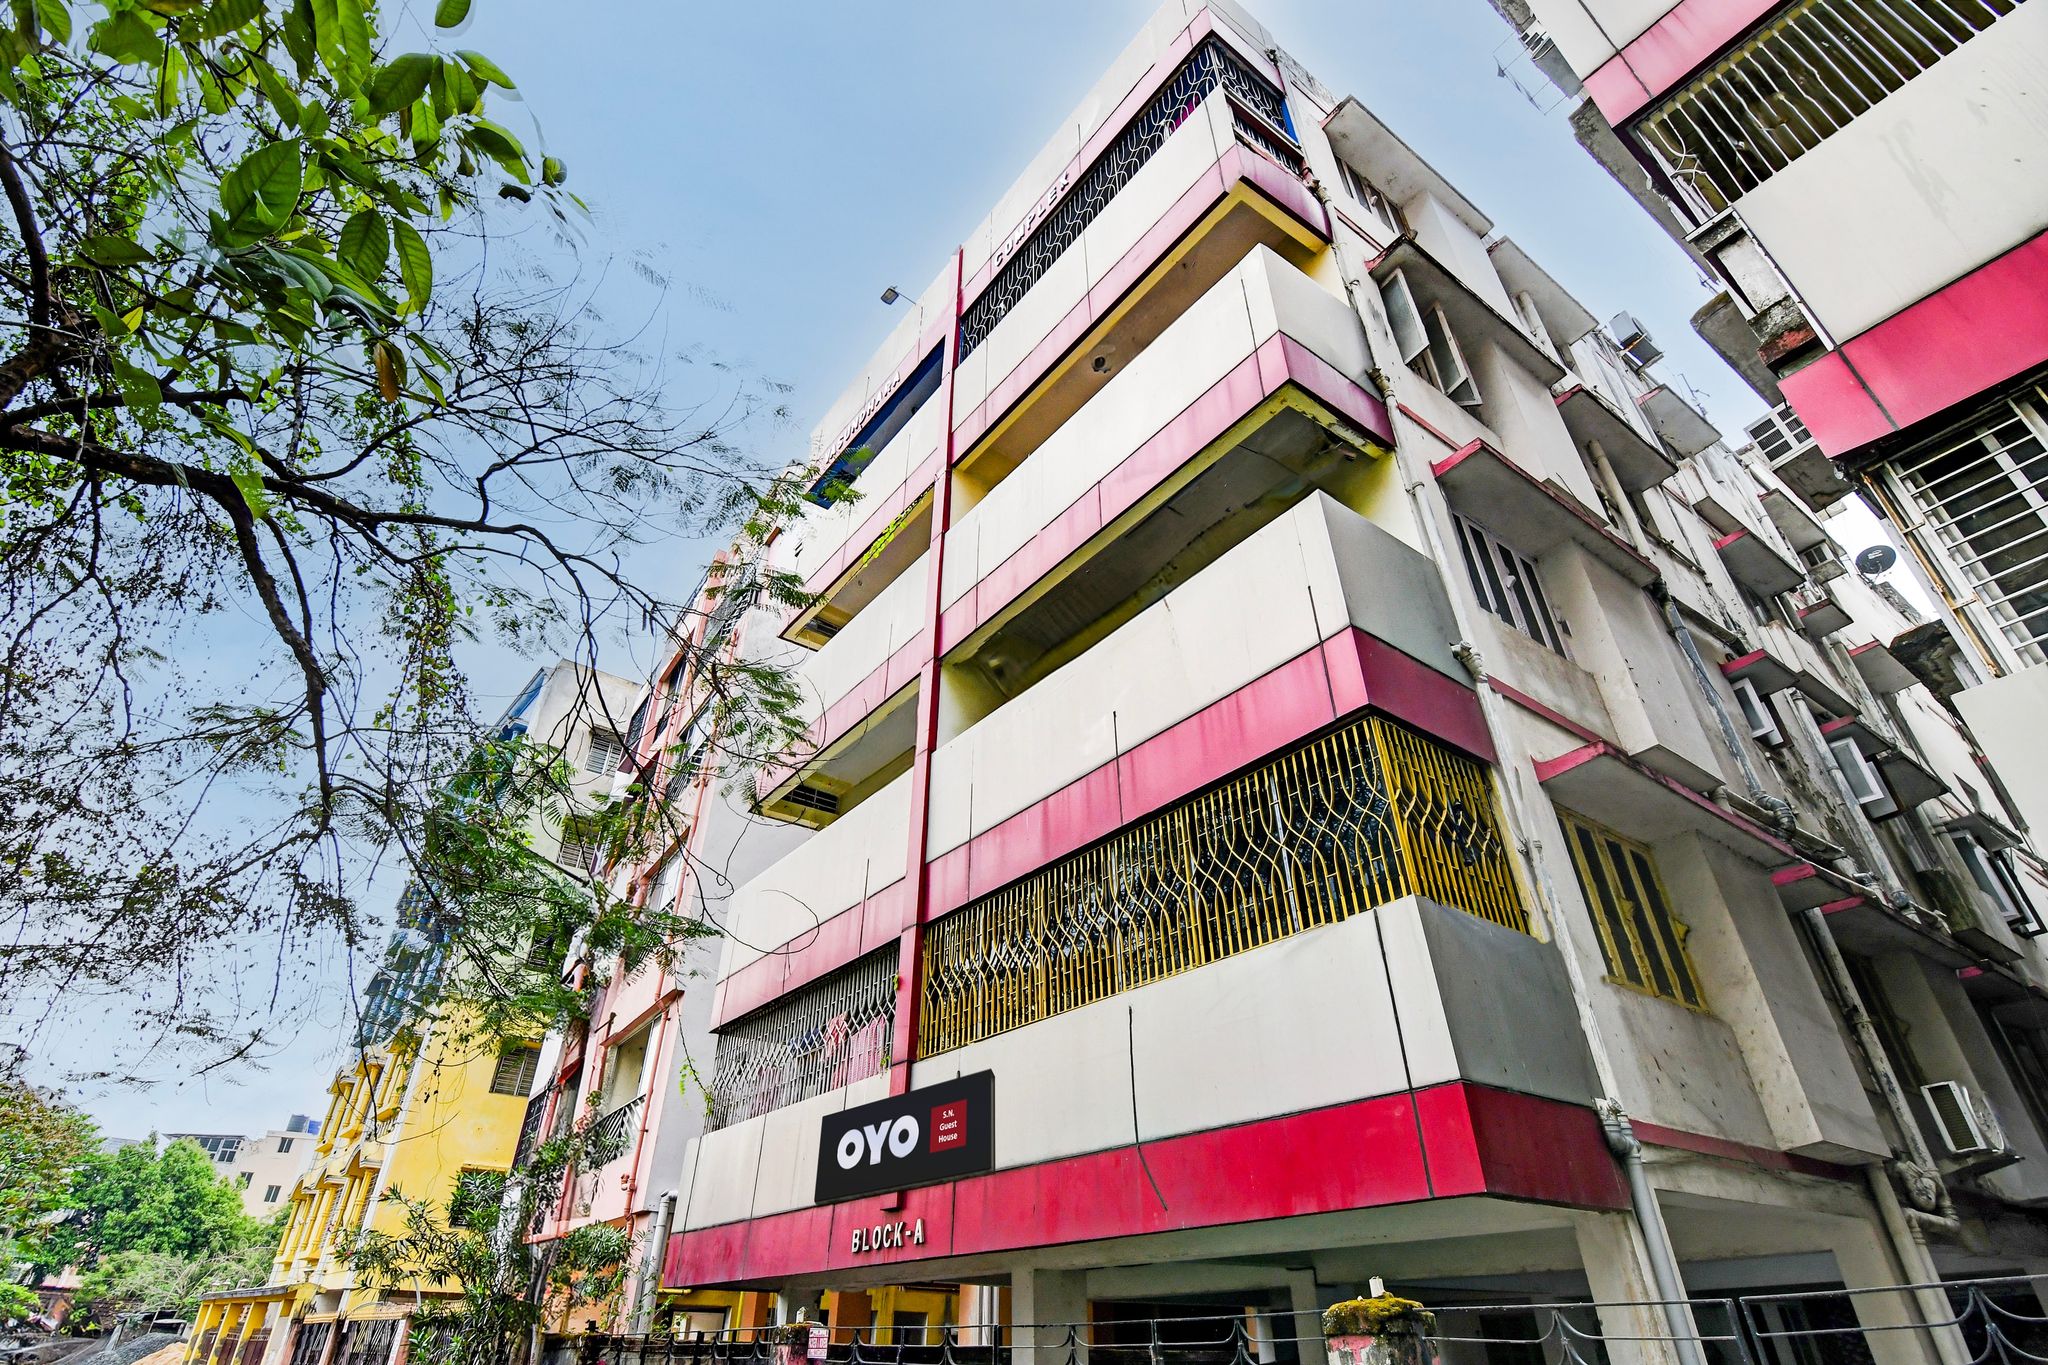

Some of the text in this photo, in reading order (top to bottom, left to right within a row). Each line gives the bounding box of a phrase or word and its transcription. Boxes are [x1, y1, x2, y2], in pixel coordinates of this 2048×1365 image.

[824, 170, 1070, 465] VASUNDHARA COMPLEX
[939, 1119, 958, 1131] Guest
[942, 1109, 955, 1119] S.N.
[837, 1115, 919, 1169] OYO
[938, 1132, 958, 1143] House
[851, 1218, 925, 1253] BLOCK-A
